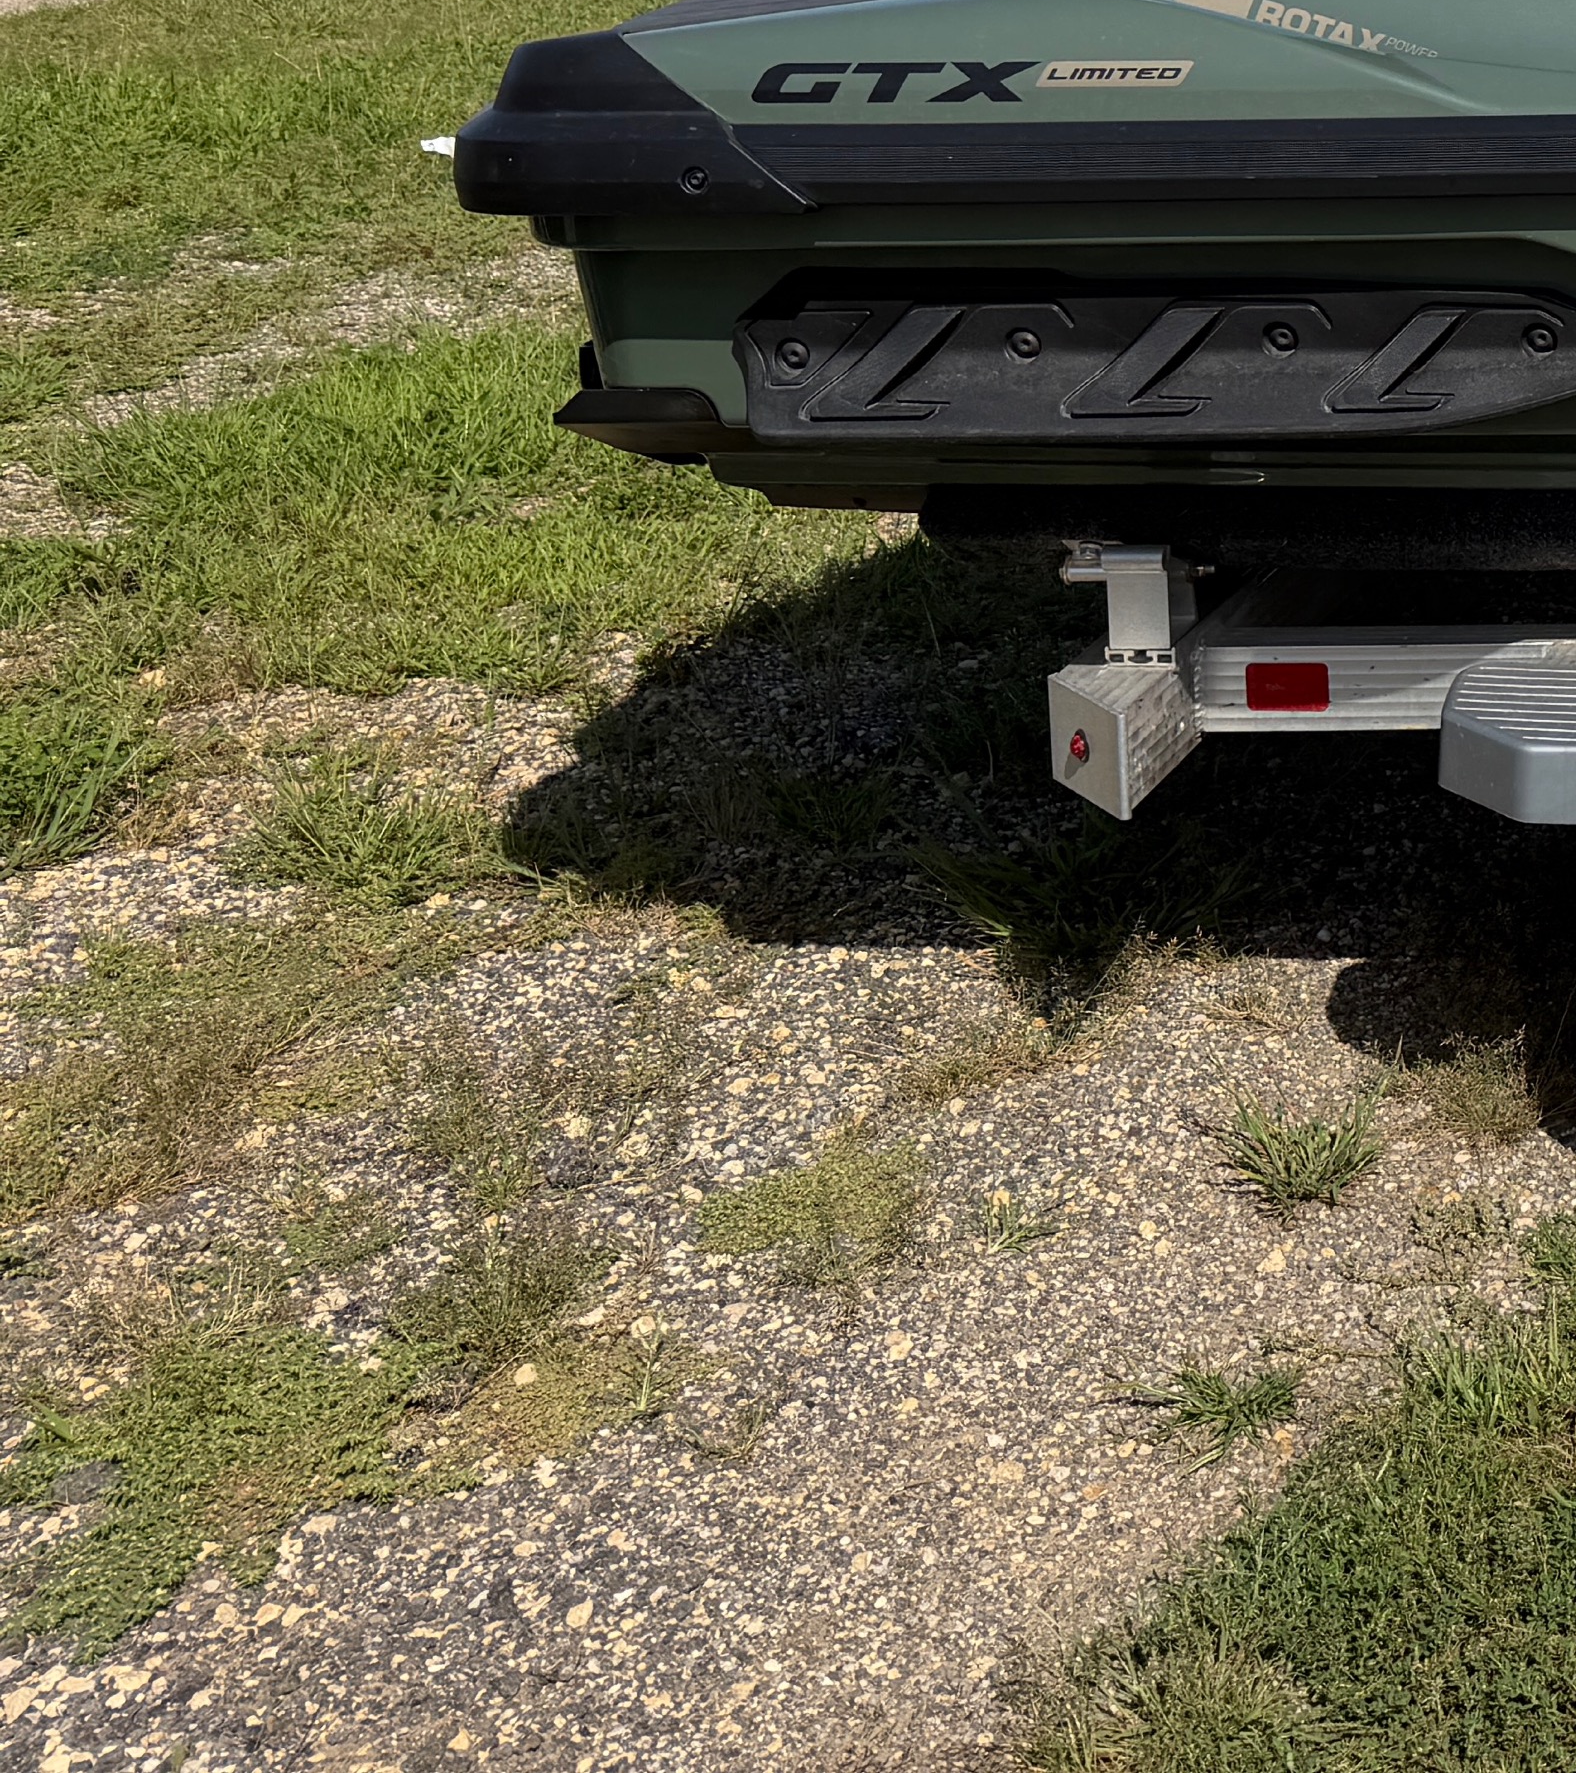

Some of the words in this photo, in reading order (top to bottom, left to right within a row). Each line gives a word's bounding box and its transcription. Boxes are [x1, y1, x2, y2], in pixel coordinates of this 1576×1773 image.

[1255, 0, 1387, 52] ROTAX
[751, 61, 1043, 103] GTX
[1046, 66, 1183, 81] LIMITED
